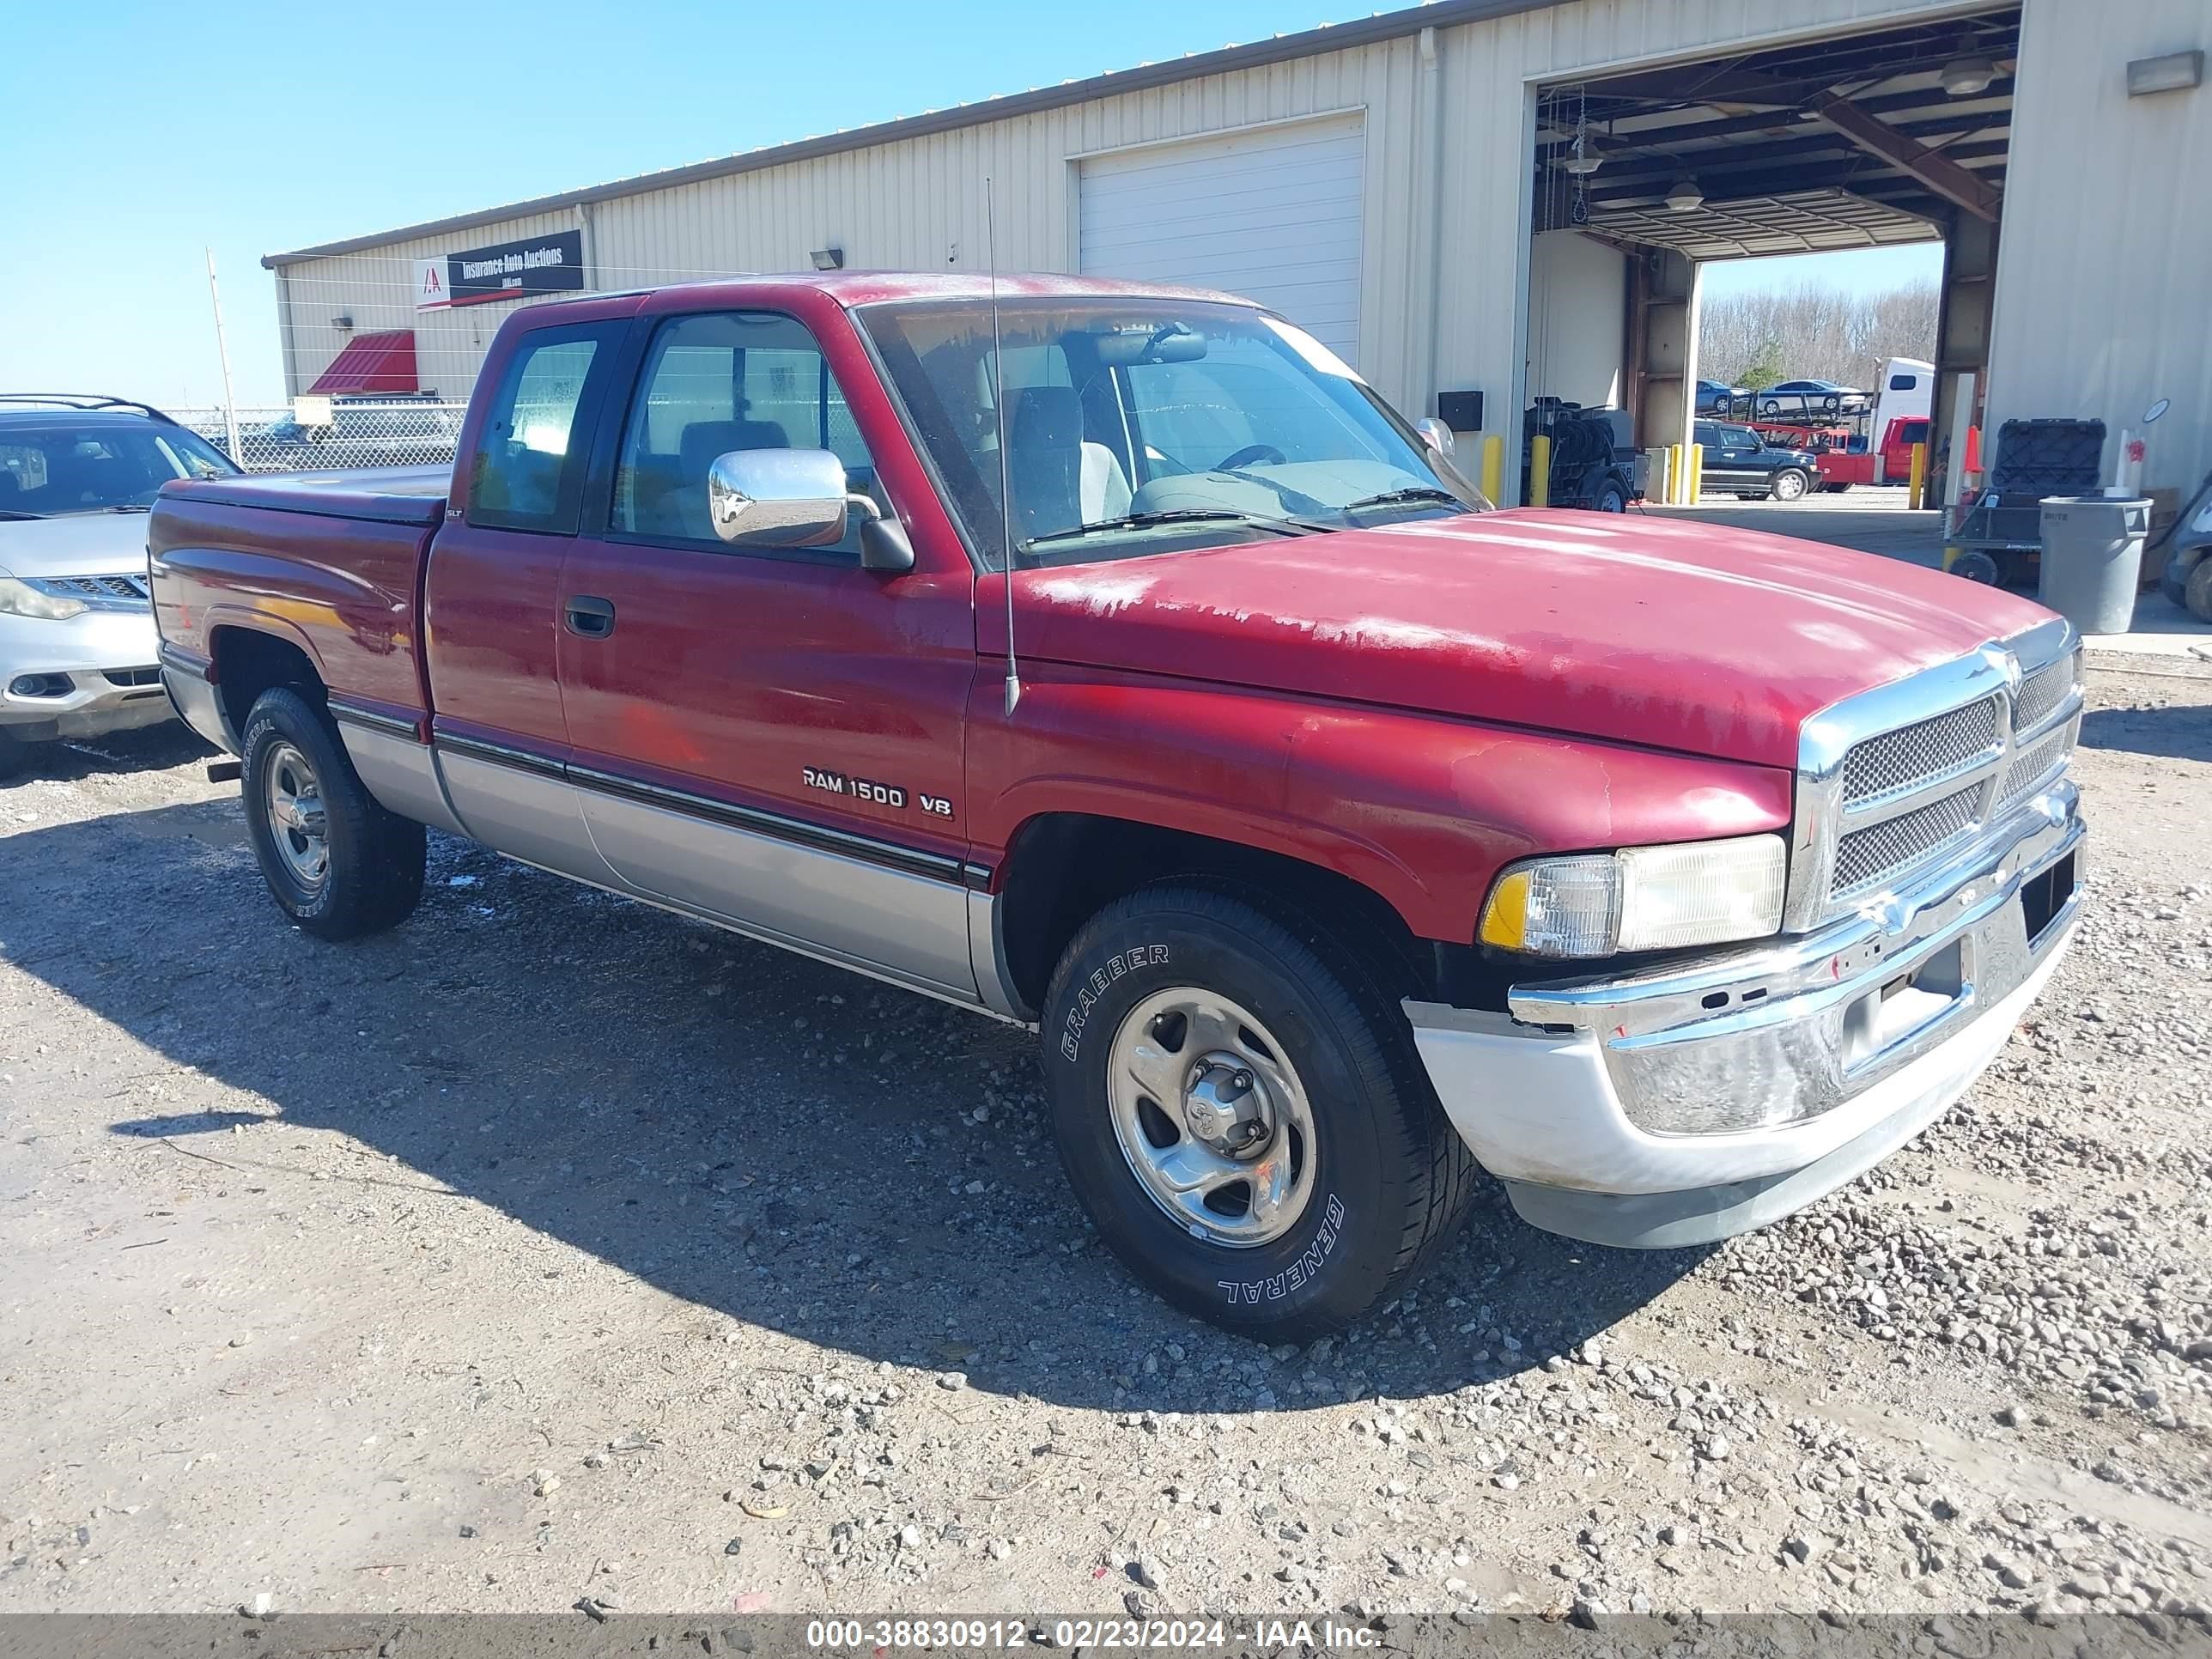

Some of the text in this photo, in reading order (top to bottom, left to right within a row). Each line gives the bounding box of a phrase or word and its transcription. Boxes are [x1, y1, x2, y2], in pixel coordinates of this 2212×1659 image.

[463, 247, 562, 280] Insurance Auto Auctions
[243, 719, 275, 781] GENERAL
[803, 769, 843, 793] RAM
[850, 781, 902, 807] 1500
[920, 795, 951, 815] V8
[1060, 945, 1170, 1062] GRABBER
[1218, 1194, 1346, 1304] GENERAL
